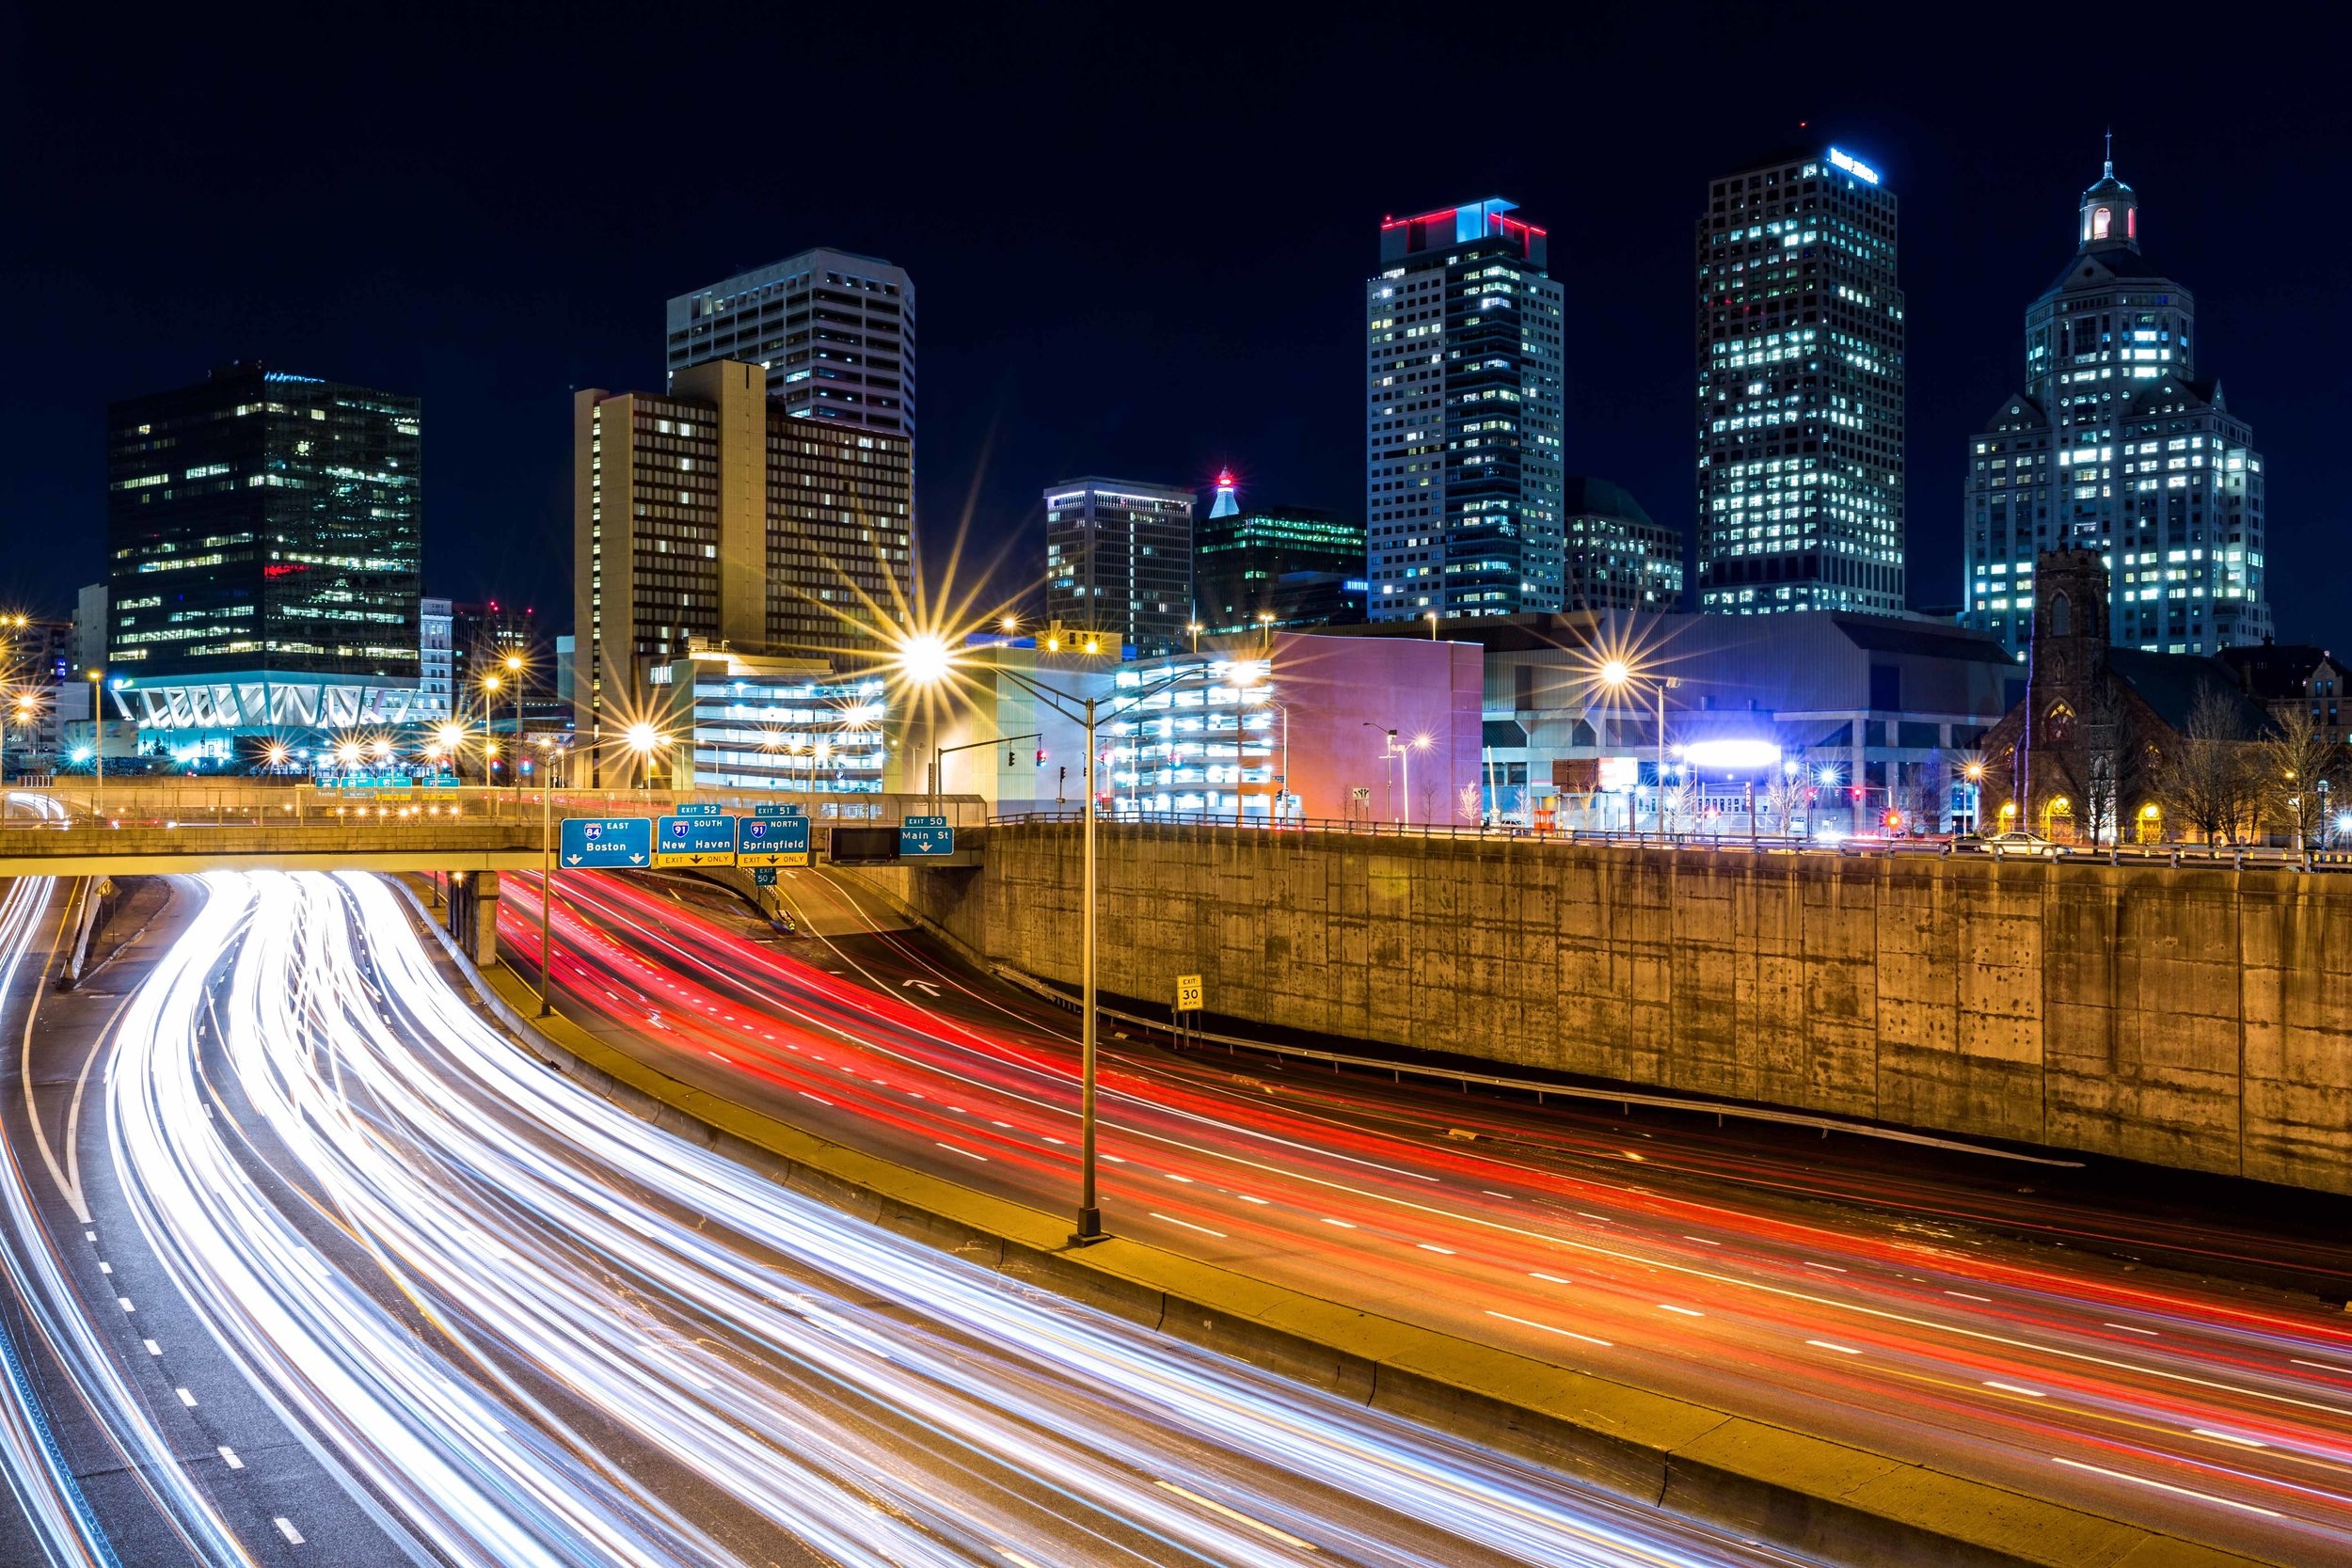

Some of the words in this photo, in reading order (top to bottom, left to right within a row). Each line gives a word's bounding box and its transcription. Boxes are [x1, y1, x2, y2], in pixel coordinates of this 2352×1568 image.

[704, 805, 717, 815] 52
[779, 806, 790, 816] 51
[693, 819, 723, 828] SOUTH
[930, 817, 943, 826] 50
[586, 828, 600, 836] 84
[675, 826, 686, 834] 91
[753, 826, 763, 834] 91
[902, 831, 929, 840] Main
[937, 831, 949, 840] St
[586, 842, 627, 851] Boston
[662, 840, 687, 849] New
[695, 839, 731, 849] Haven
[742, 840, 804, 851] Springfield
[707, 855, 729, 863] ONLY
[1183, 989, 1199, 1000] 30
